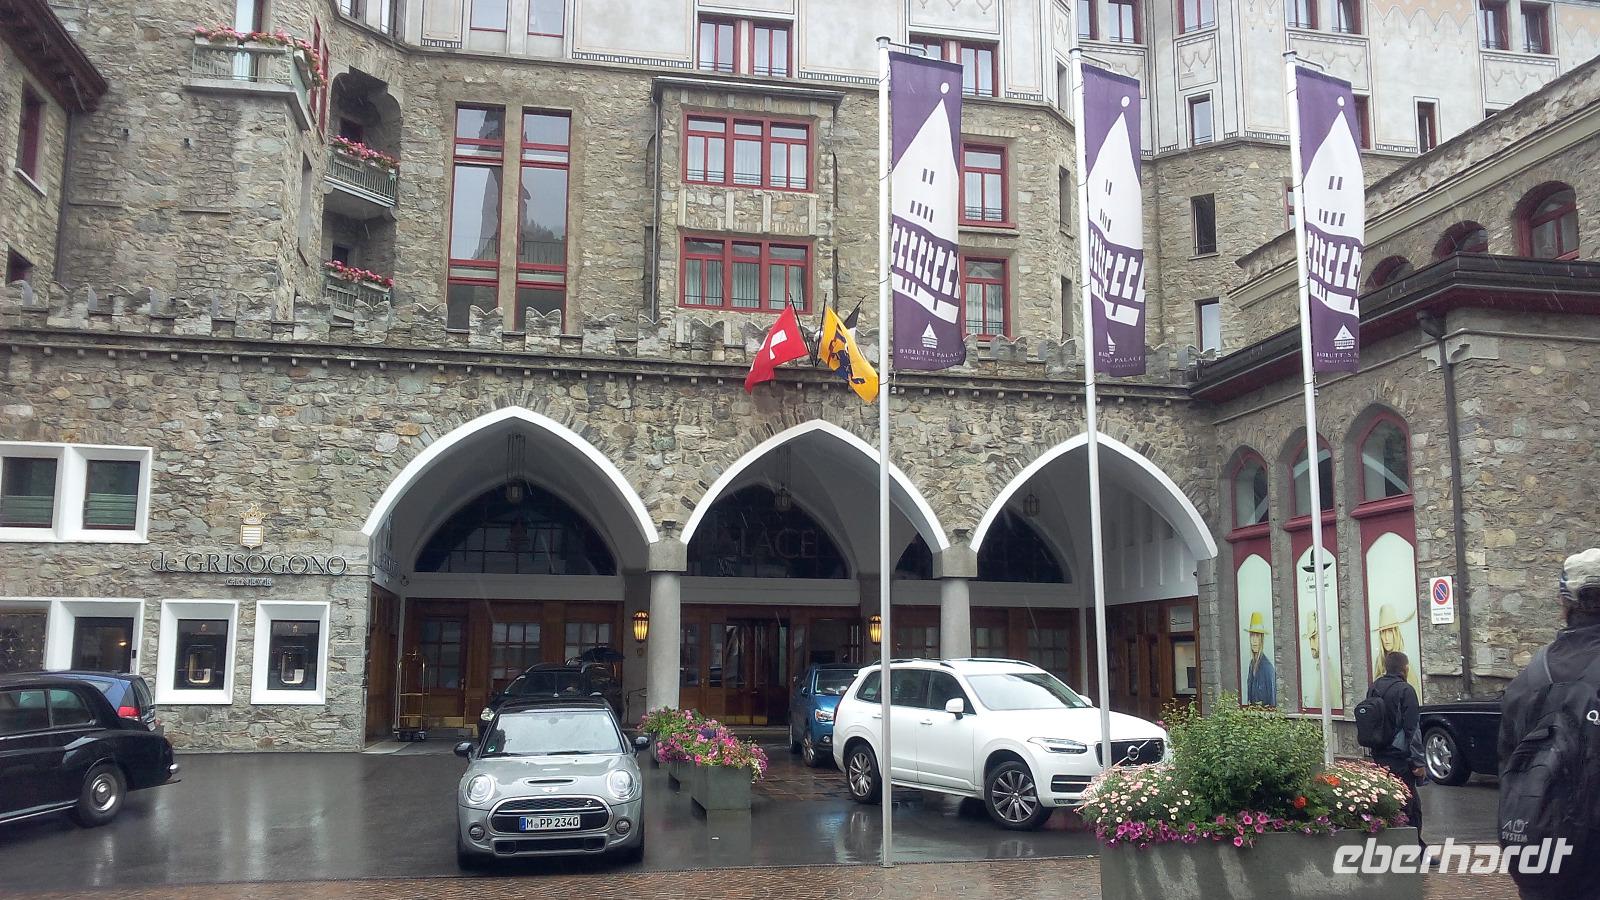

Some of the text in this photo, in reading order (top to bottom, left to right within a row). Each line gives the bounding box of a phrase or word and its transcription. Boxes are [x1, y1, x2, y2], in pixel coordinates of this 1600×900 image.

[150, 552, 348, 575] de GRISOGONO
[526, 816, 579, 828] M PP 2340
[1501, 831, 1528, 843] SYSTEM
